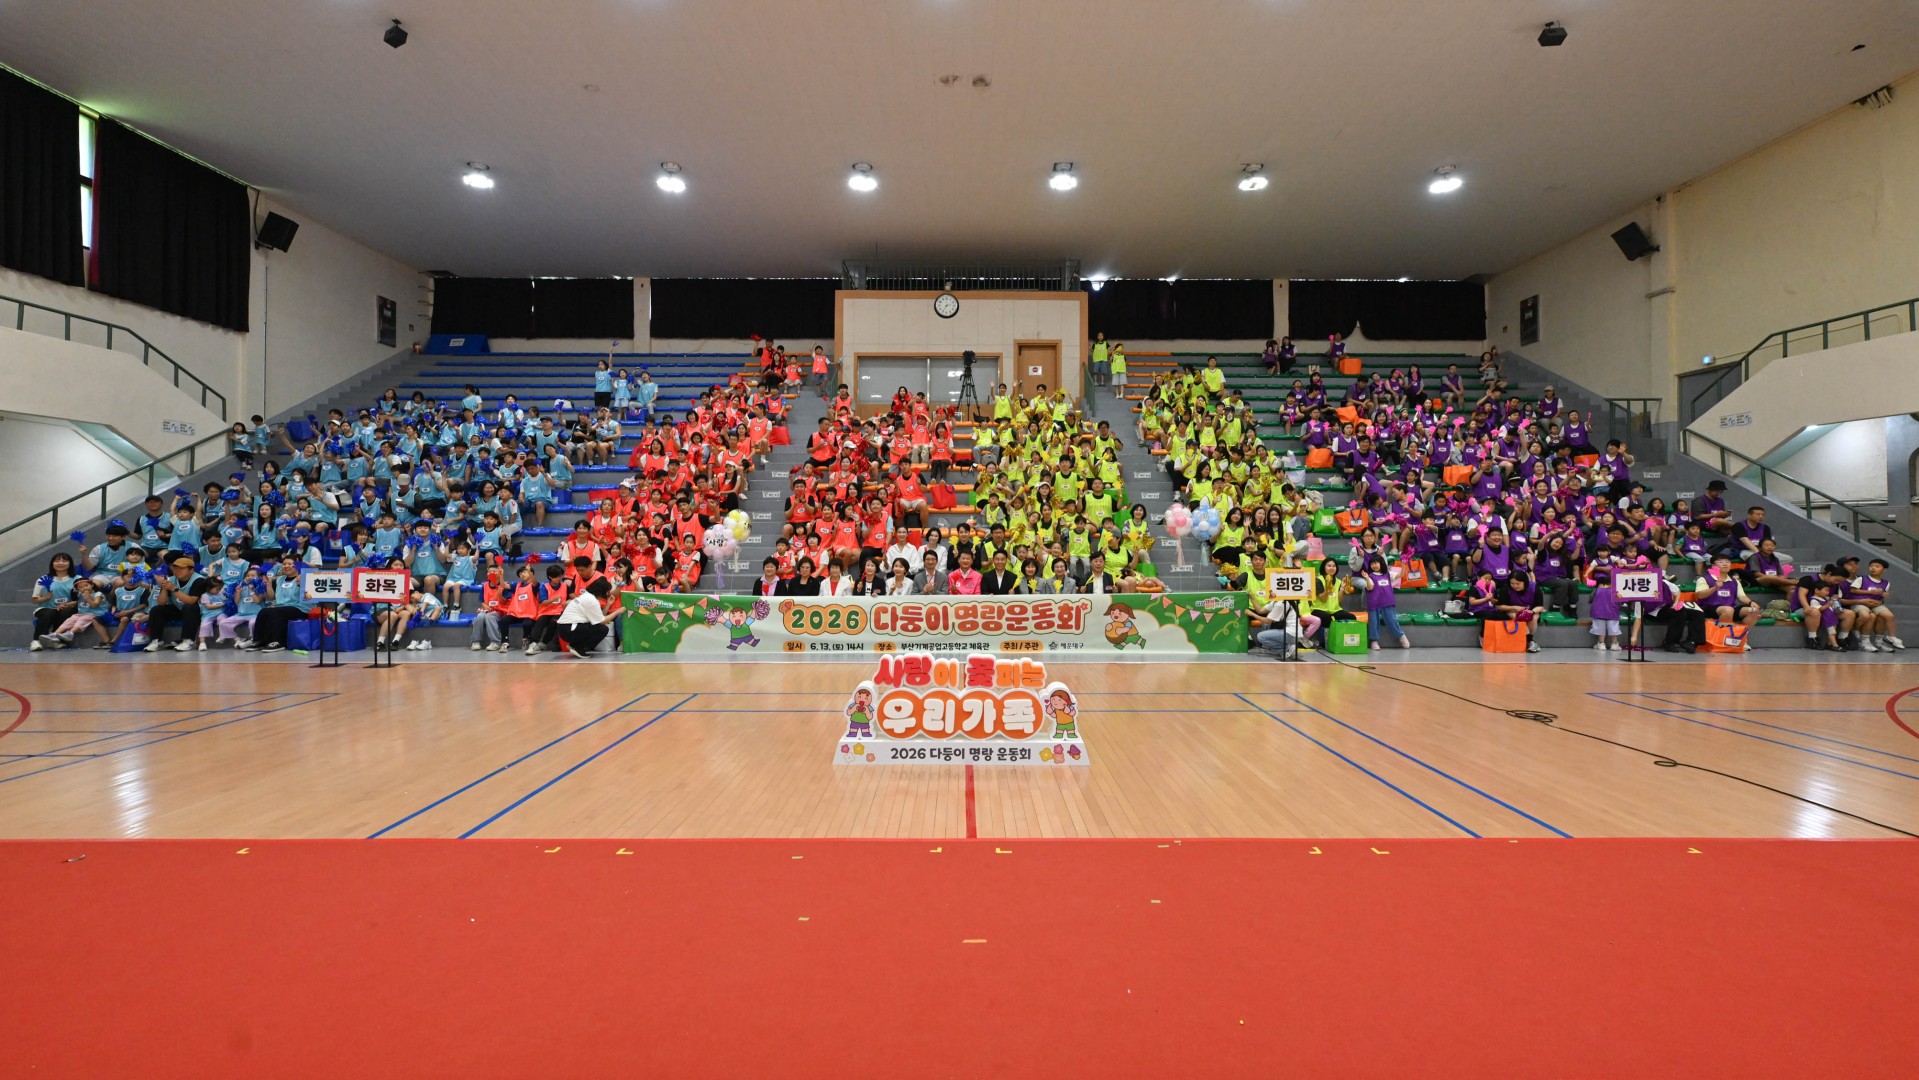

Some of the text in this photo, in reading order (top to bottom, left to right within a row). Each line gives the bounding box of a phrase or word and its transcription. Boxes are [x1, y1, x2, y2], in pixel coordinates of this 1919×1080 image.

[314, 578, 342, 593] 행복
[365, 578, 397, 594] 화목
[1276, 577, 1304, 591] 희망
[1622, 578, 1651, 592] 사랑
[791, 609, 860, 630] 2026
[787, 642, 802, 650] 일시
[877, 642, 990, 651] 장소 부산기계공업고등학교 체육관
[1003, 642, 1018, 650] 주최
[1024, 642, 1039, 650] 주관
[874, 655, 1046, 688] 사랑이 꽃피는
[882, 698, 1036, 734] 우리가족
[891, 747, 1031, 761] 2026 다둥이 명랑 운동회
